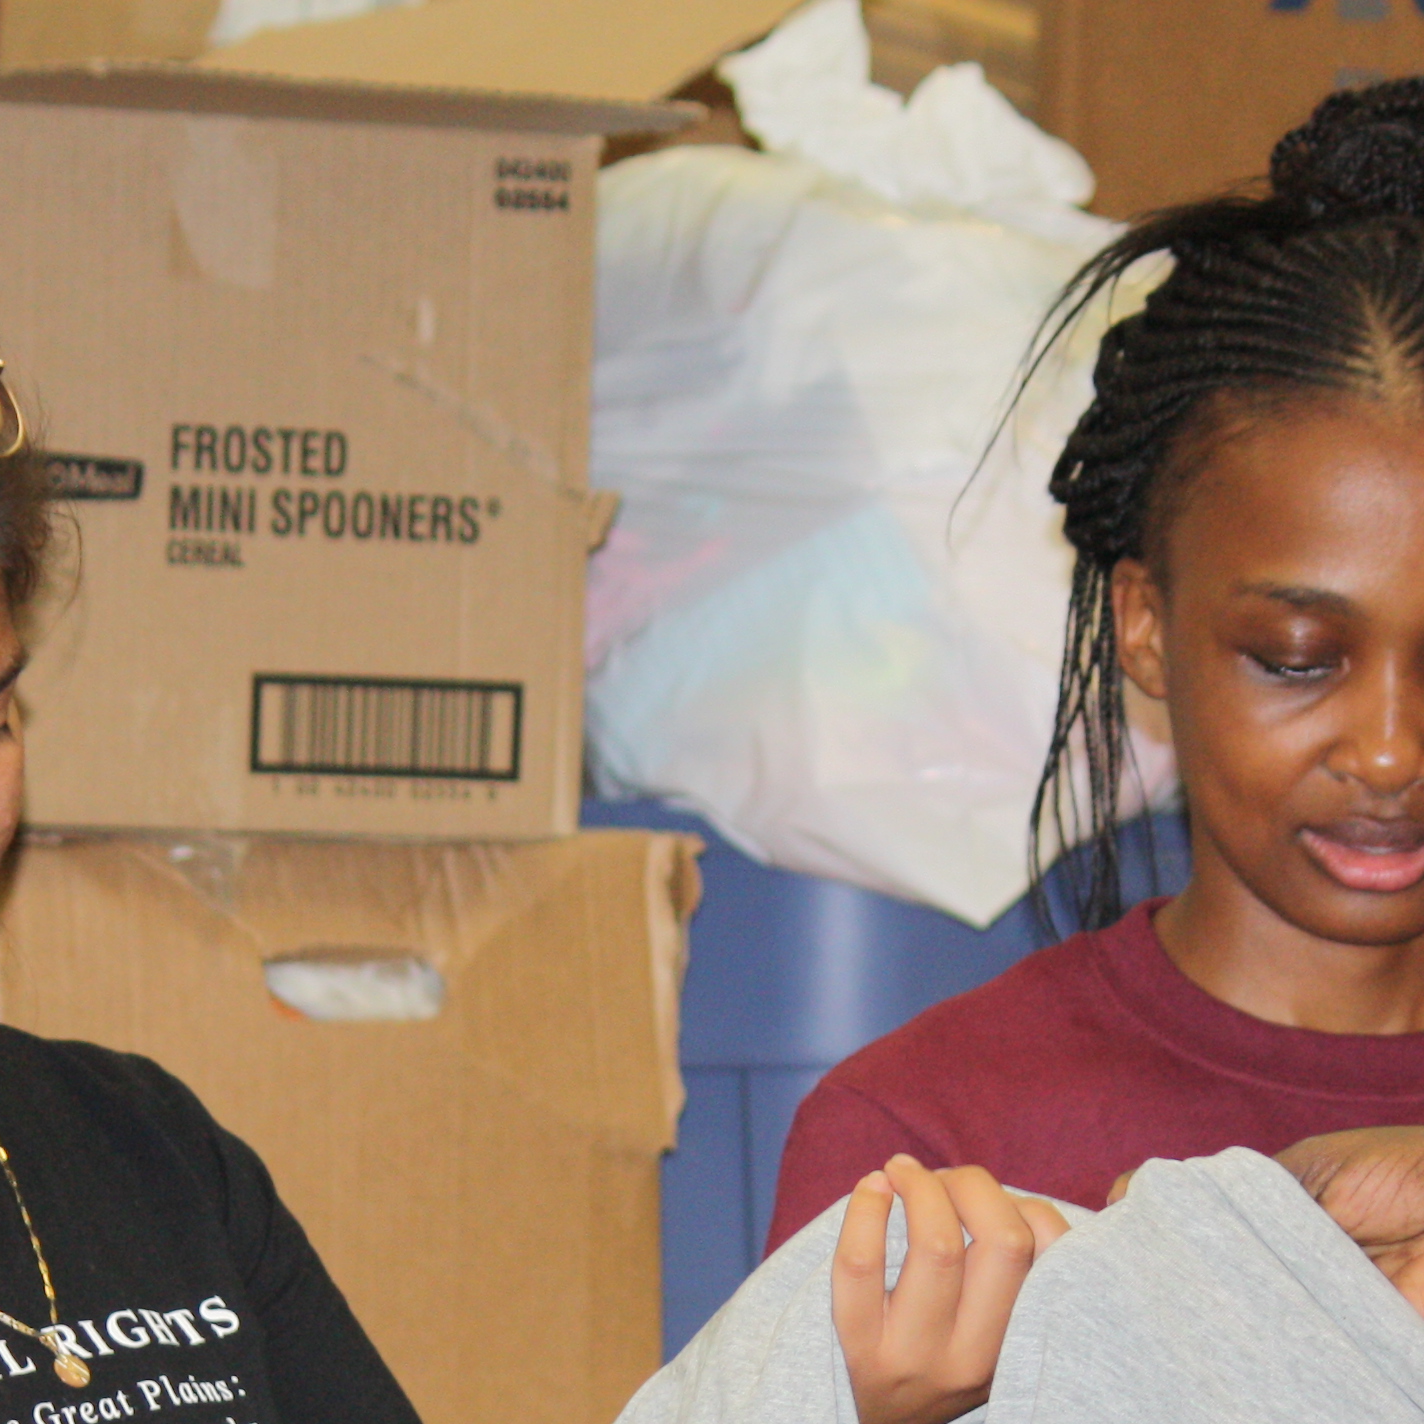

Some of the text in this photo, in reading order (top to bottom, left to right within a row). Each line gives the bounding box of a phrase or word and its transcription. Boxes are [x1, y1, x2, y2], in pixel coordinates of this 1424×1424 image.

[169, 423, 350, 478] FROSTED
[167, 485, 257, 534] MINI
[166, 539, 244, 567] CEREAL
[40, 1295, 241, 1360] RIGHTS
[137, 1374, 247, 1413] Plains:
